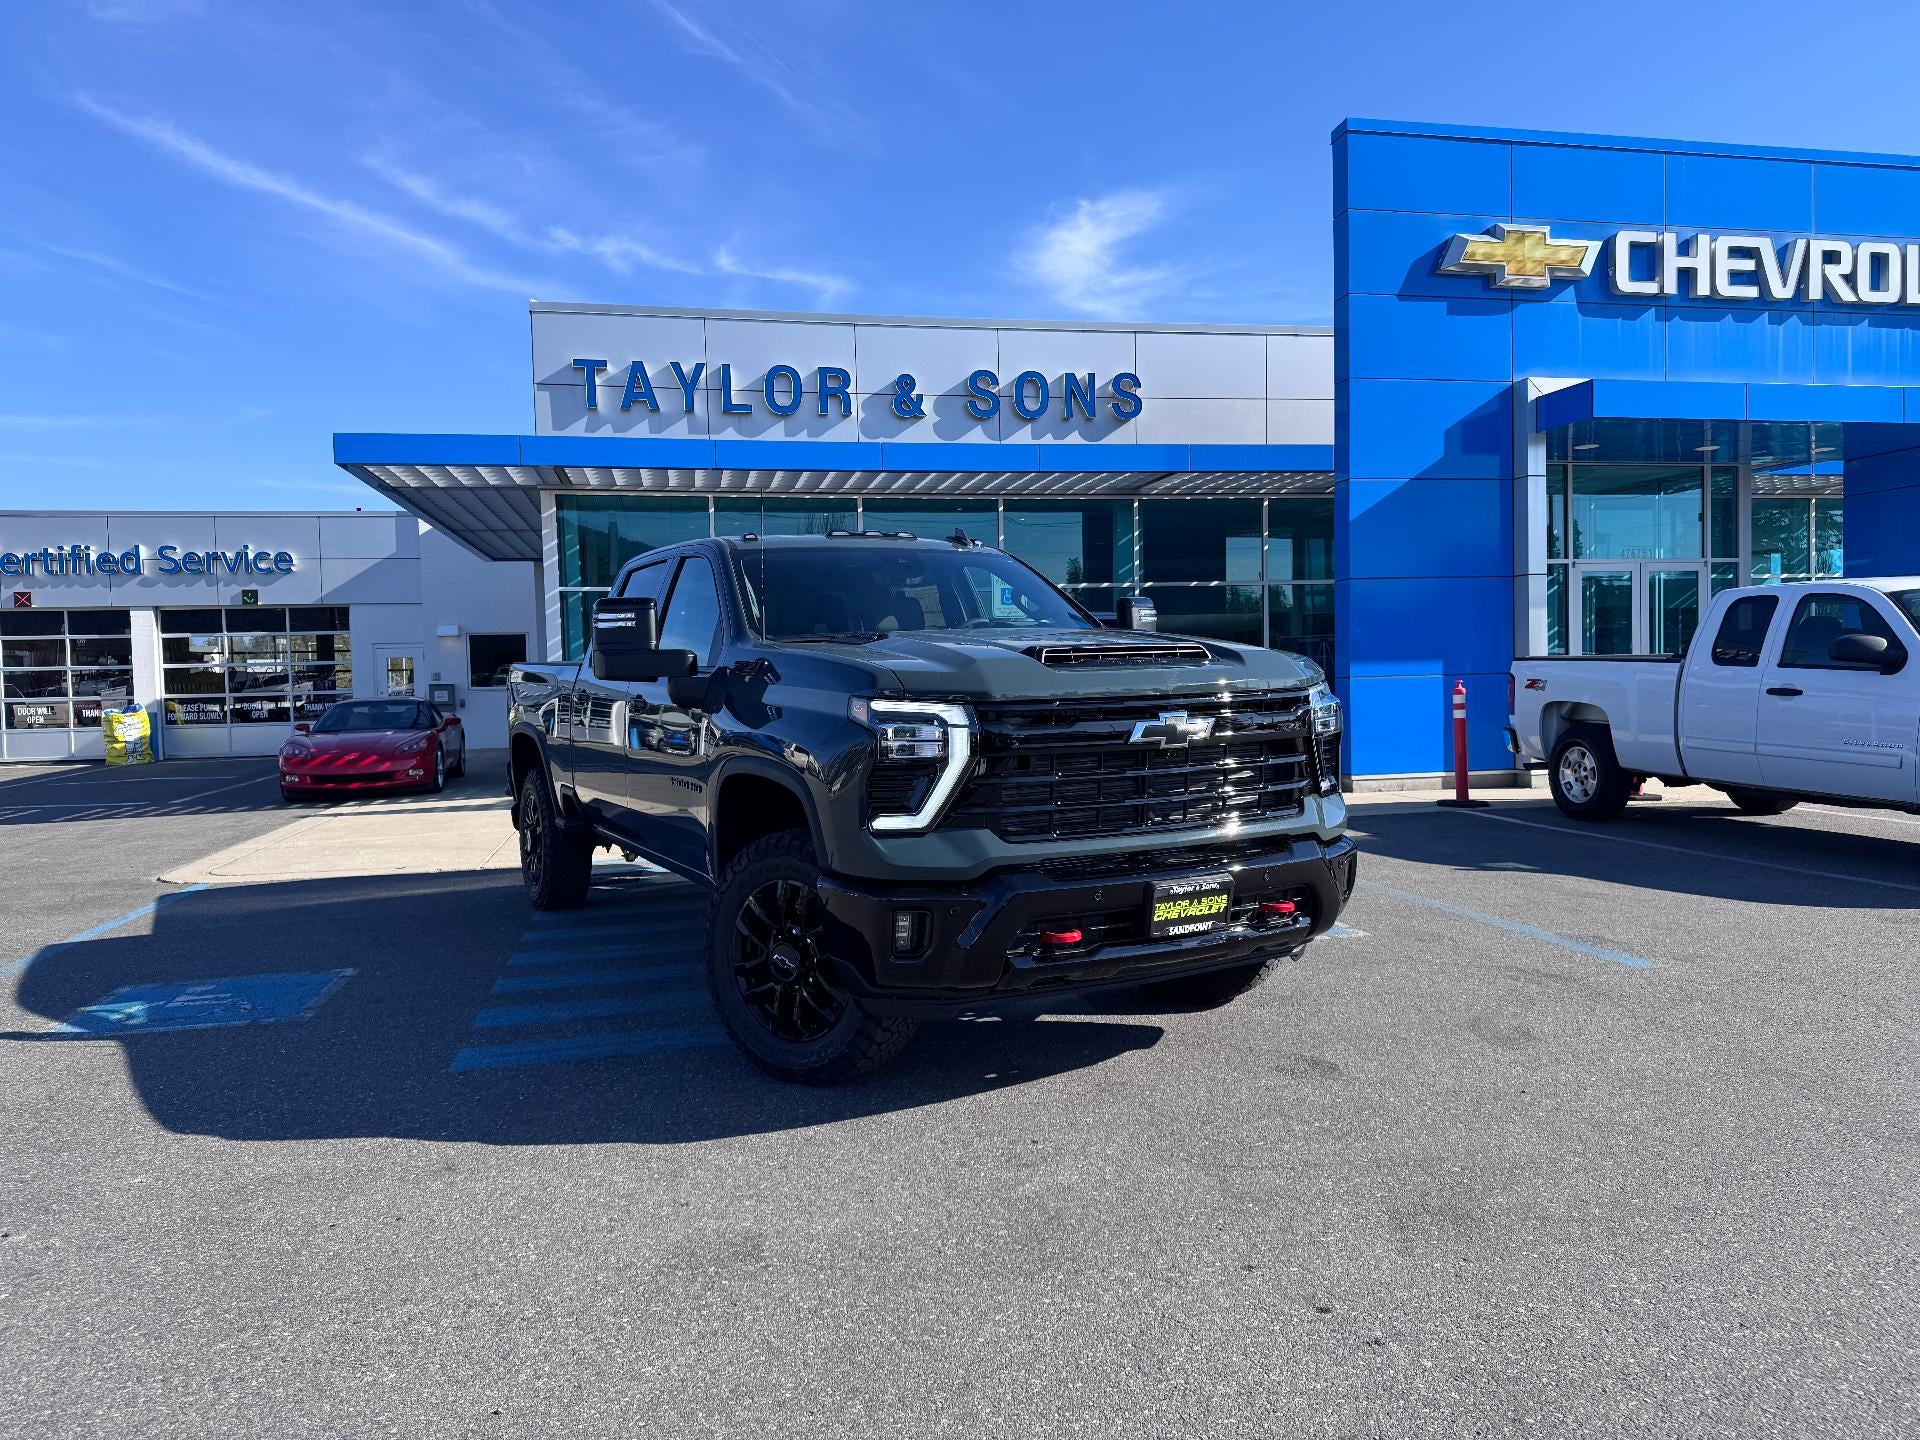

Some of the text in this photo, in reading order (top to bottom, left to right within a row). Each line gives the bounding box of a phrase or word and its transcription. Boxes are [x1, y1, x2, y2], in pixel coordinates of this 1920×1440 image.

[572, 358, 1143, 420] TAYLOR & SONS
[157, 544, 295, 575] Service
[17, 706, 53, 716] DOOR WILL
[174, 703, 199, 712] PLEASE
[303, 703, 323, 711] THANK
[81, 709, 101, 718] THAN
[167, 711, 224, 721] FORWARD SLOWLY
[251, 710, 269, 719] OPEN
[26, 715, 44, 724] OPEN
[1155, 894, 1228, 911] TAYLOR & SONS
[1154, 903, 1227, 921] CHEVROLET
[1168, 921, 1213, 936] SANDPOINT
